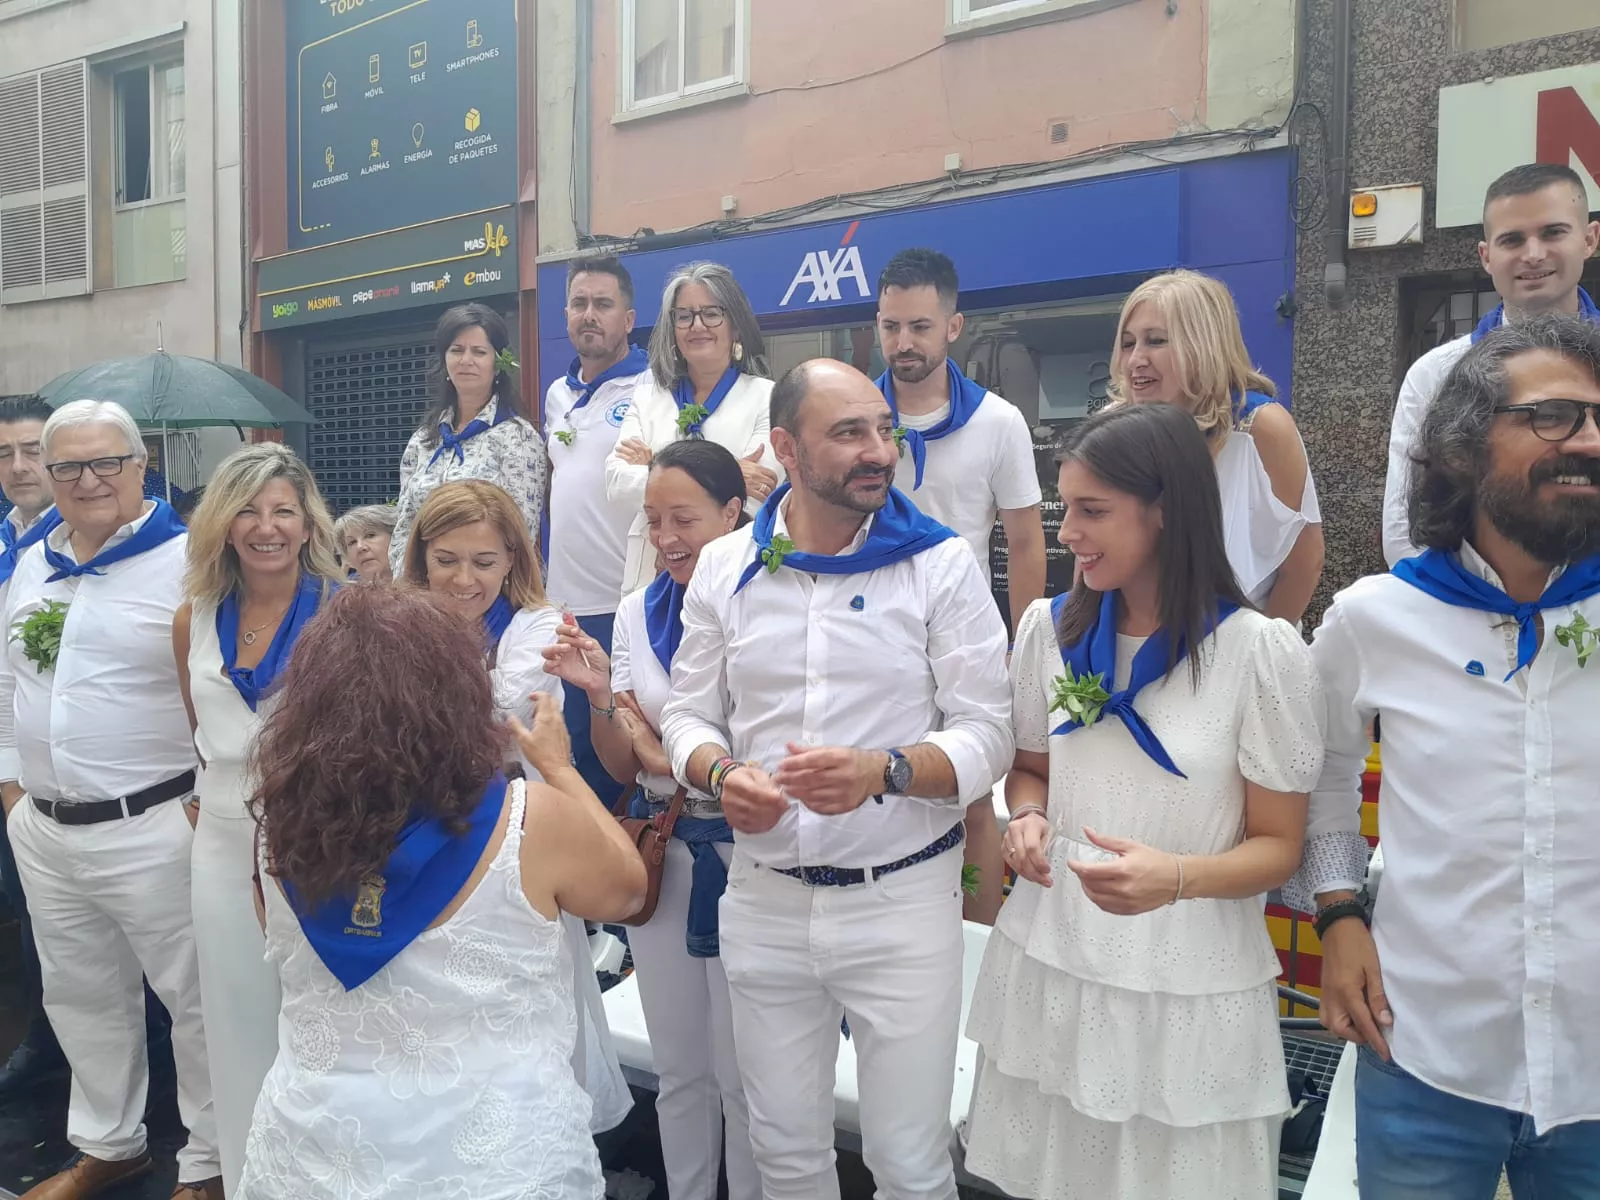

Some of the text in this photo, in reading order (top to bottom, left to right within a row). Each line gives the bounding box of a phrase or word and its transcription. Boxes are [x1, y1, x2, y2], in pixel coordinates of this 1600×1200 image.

[446, 48, 500, 72] SMARTPHONES
[409, 71, 426, 84] TELE
[365, 86, 384, 99] MÓVIL
[321, 102, 338, 114] FIBRA
[454, 133, 492, 150] RECOGIDA
[404, 148, 433, 164] ENERGÍA
[448, 144, 498, 165] DE PAQUETES
[360, 160, 390, 176] ALARMAS
[312, 172, 349, 189] ACCESORIOS
[272, 301, 299, 318] yoigo
[464, 268, 501, 286] embou
